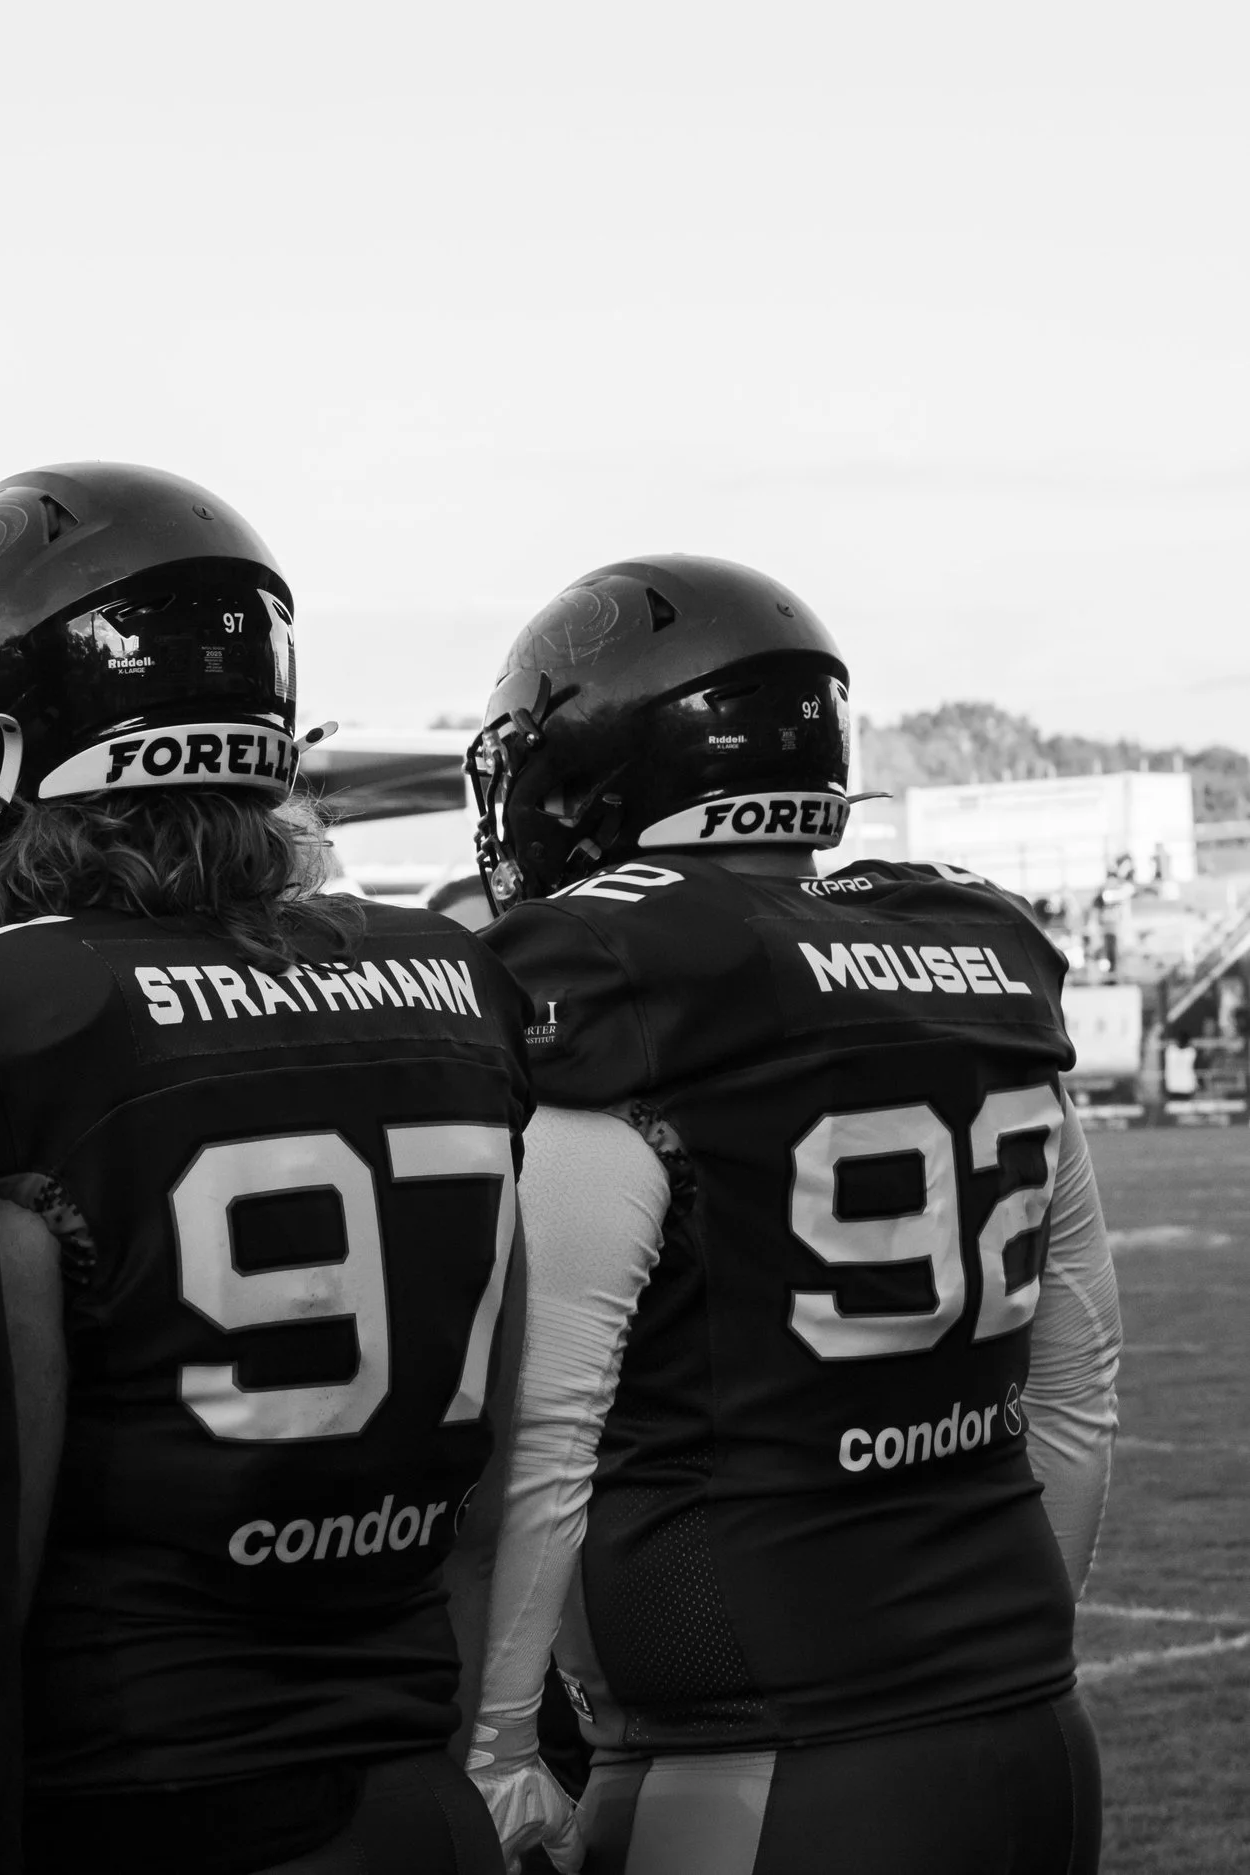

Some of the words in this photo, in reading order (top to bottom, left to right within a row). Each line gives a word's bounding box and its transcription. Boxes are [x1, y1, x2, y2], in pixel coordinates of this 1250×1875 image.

[223, 612, 244, 634] 97
[107, 656, 152, 669] Riddell
[708, 735, 745, 745] Riddell
[801, 701, 820, 719] 92
[134, 958, 482, 1026] STRATHMANN
[797, 942, 1032, 994] MOUSEL
[787, 1083, 1065, 1361] 92
[167, 1120, 516, 1444] 97
[838, 1401, 998, 1472] condor
[228, 1494, 447, 1567] condor
